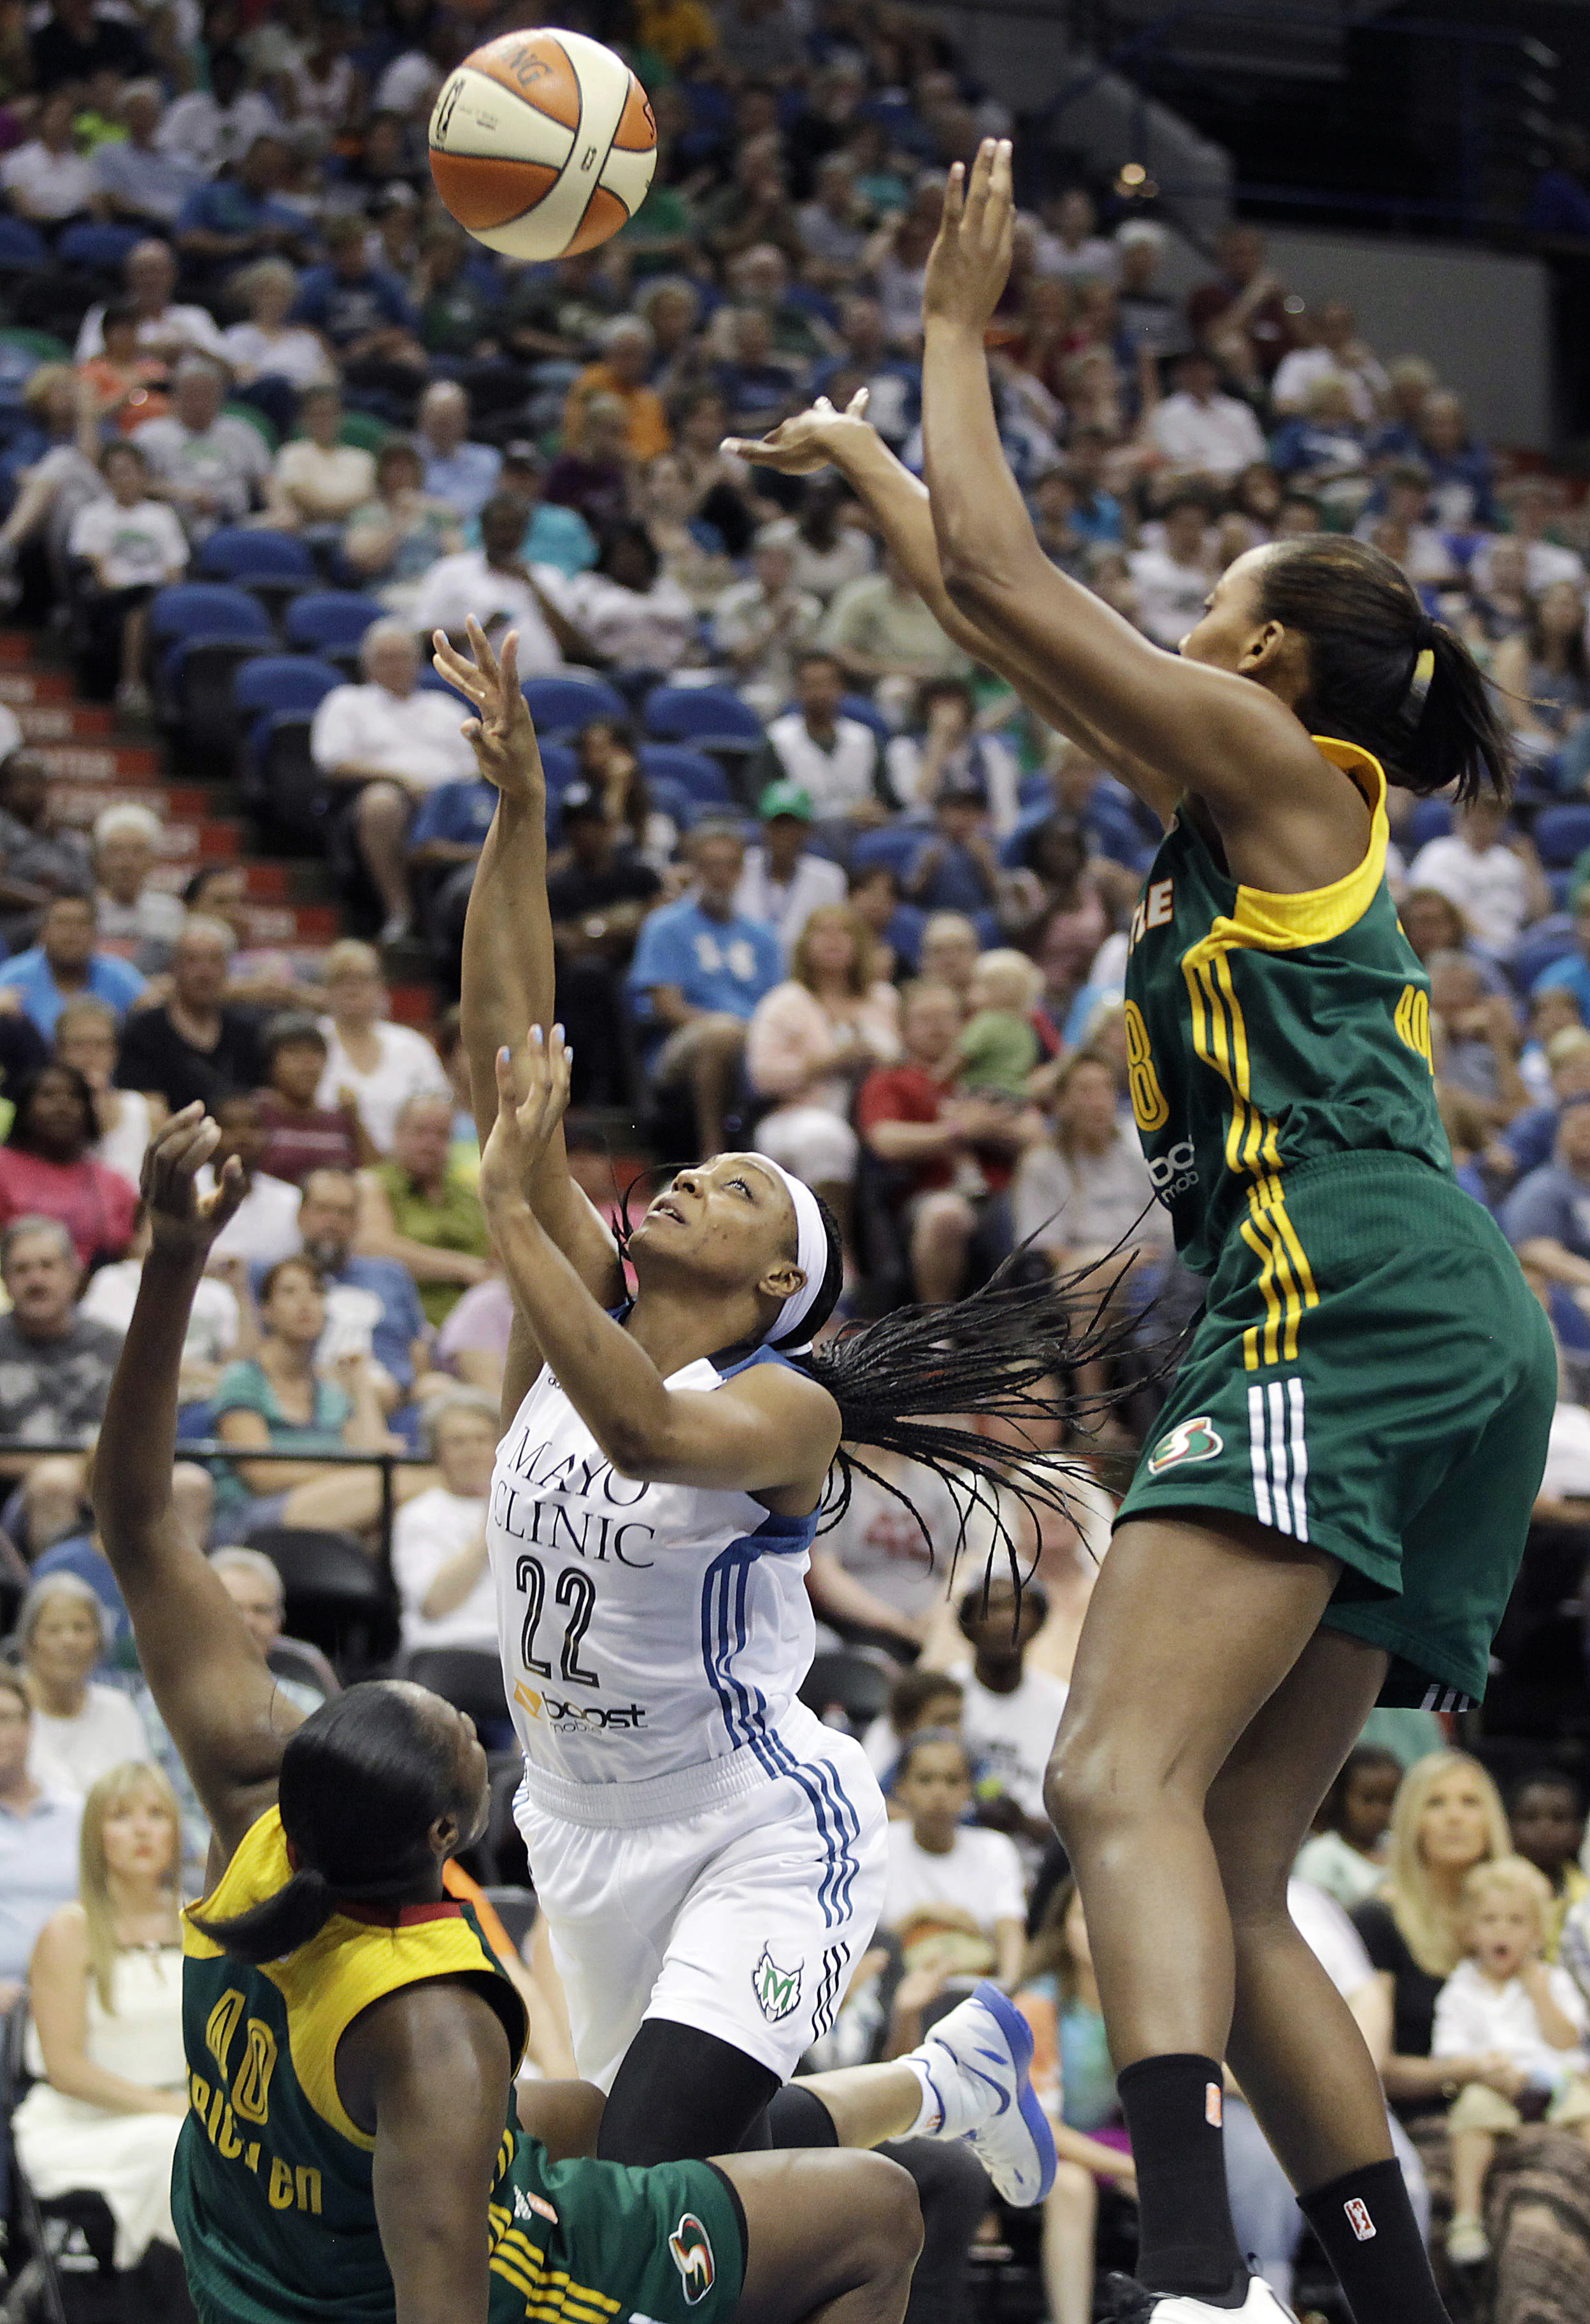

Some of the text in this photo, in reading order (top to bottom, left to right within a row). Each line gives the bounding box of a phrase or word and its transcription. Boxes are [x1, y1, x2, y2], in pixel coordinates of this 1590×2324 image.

[508, 1426, 650, 1506] MAYO
[494, 1480, 655, 1568] CLINIC
[516, 1554, 600, 1688] 22
[541, 1691, 648, 1729] boost
